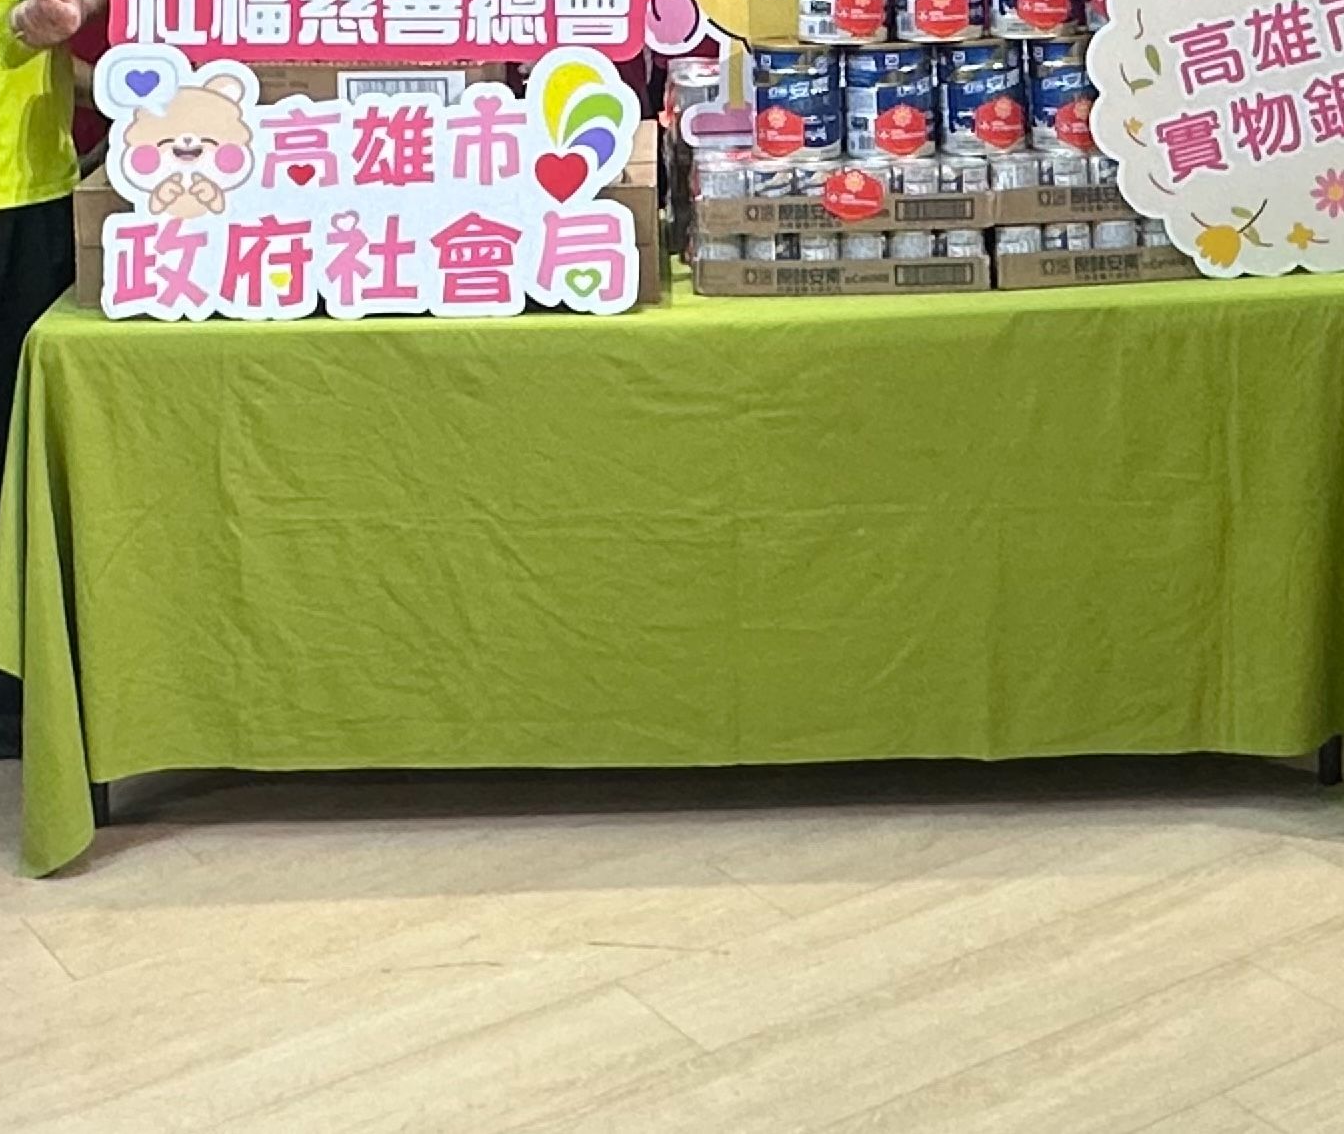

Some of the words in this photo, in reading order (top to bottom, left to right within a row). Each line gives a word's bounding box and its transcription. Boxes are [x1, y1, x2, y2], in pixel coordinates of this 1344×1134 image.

[260, 97, 526, 187] 高雄市
[113, 200, 625, 307] 政府社會局
